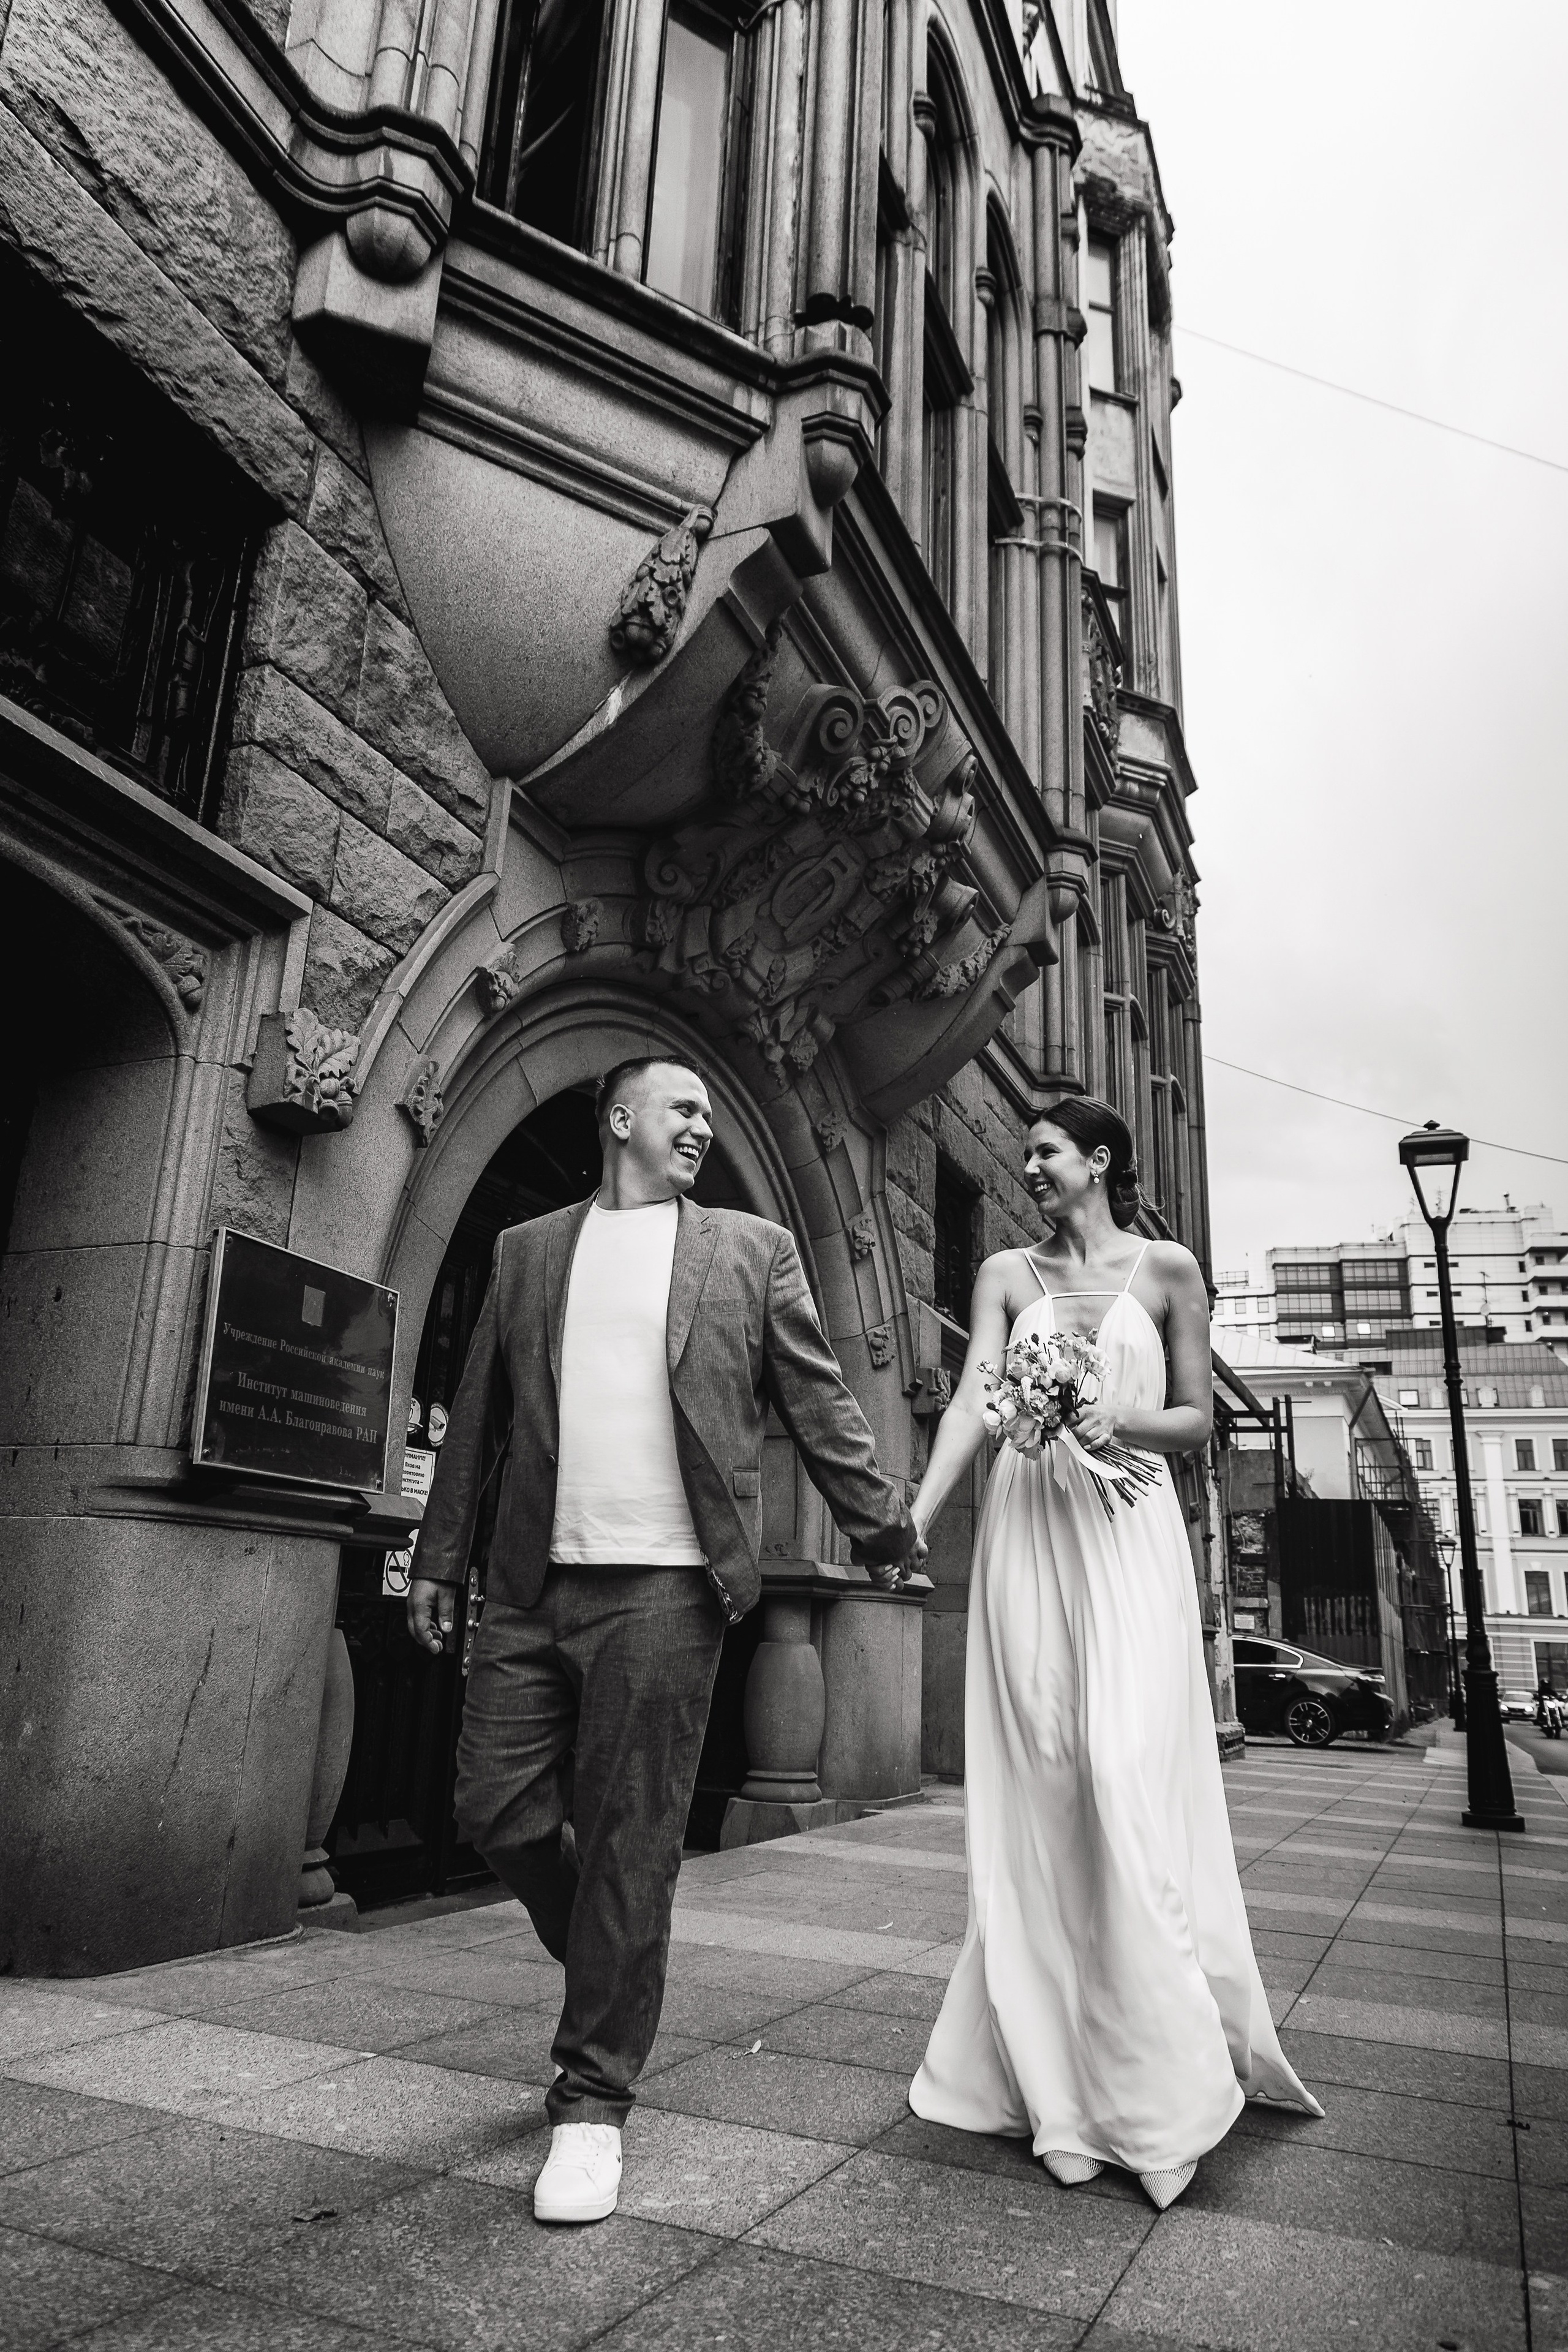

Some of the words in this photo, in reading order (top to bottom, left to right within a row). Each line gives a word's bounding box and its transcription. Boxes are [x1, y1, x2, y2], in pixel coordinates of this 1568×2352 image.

[223, 1322, 277, 1349] Учреждение
[279, 1339, 326, 1363] Российской
[329, 1356, 366, 1374] академии
[368, 1367, 385, 1379] наук
[237, 1371, 288, 1400] Институт
[290, 1389, 368, 1417] машиноведения
[219, 1400, 255, 1418] имени
[257, 1404, 282, 1423] А.А.
[285, 1410, 353, 1439] Благонравова
[356, 1426, 378, 1444] РАН
[405, 1452, 426, 1461] НИМАНИЕ!
